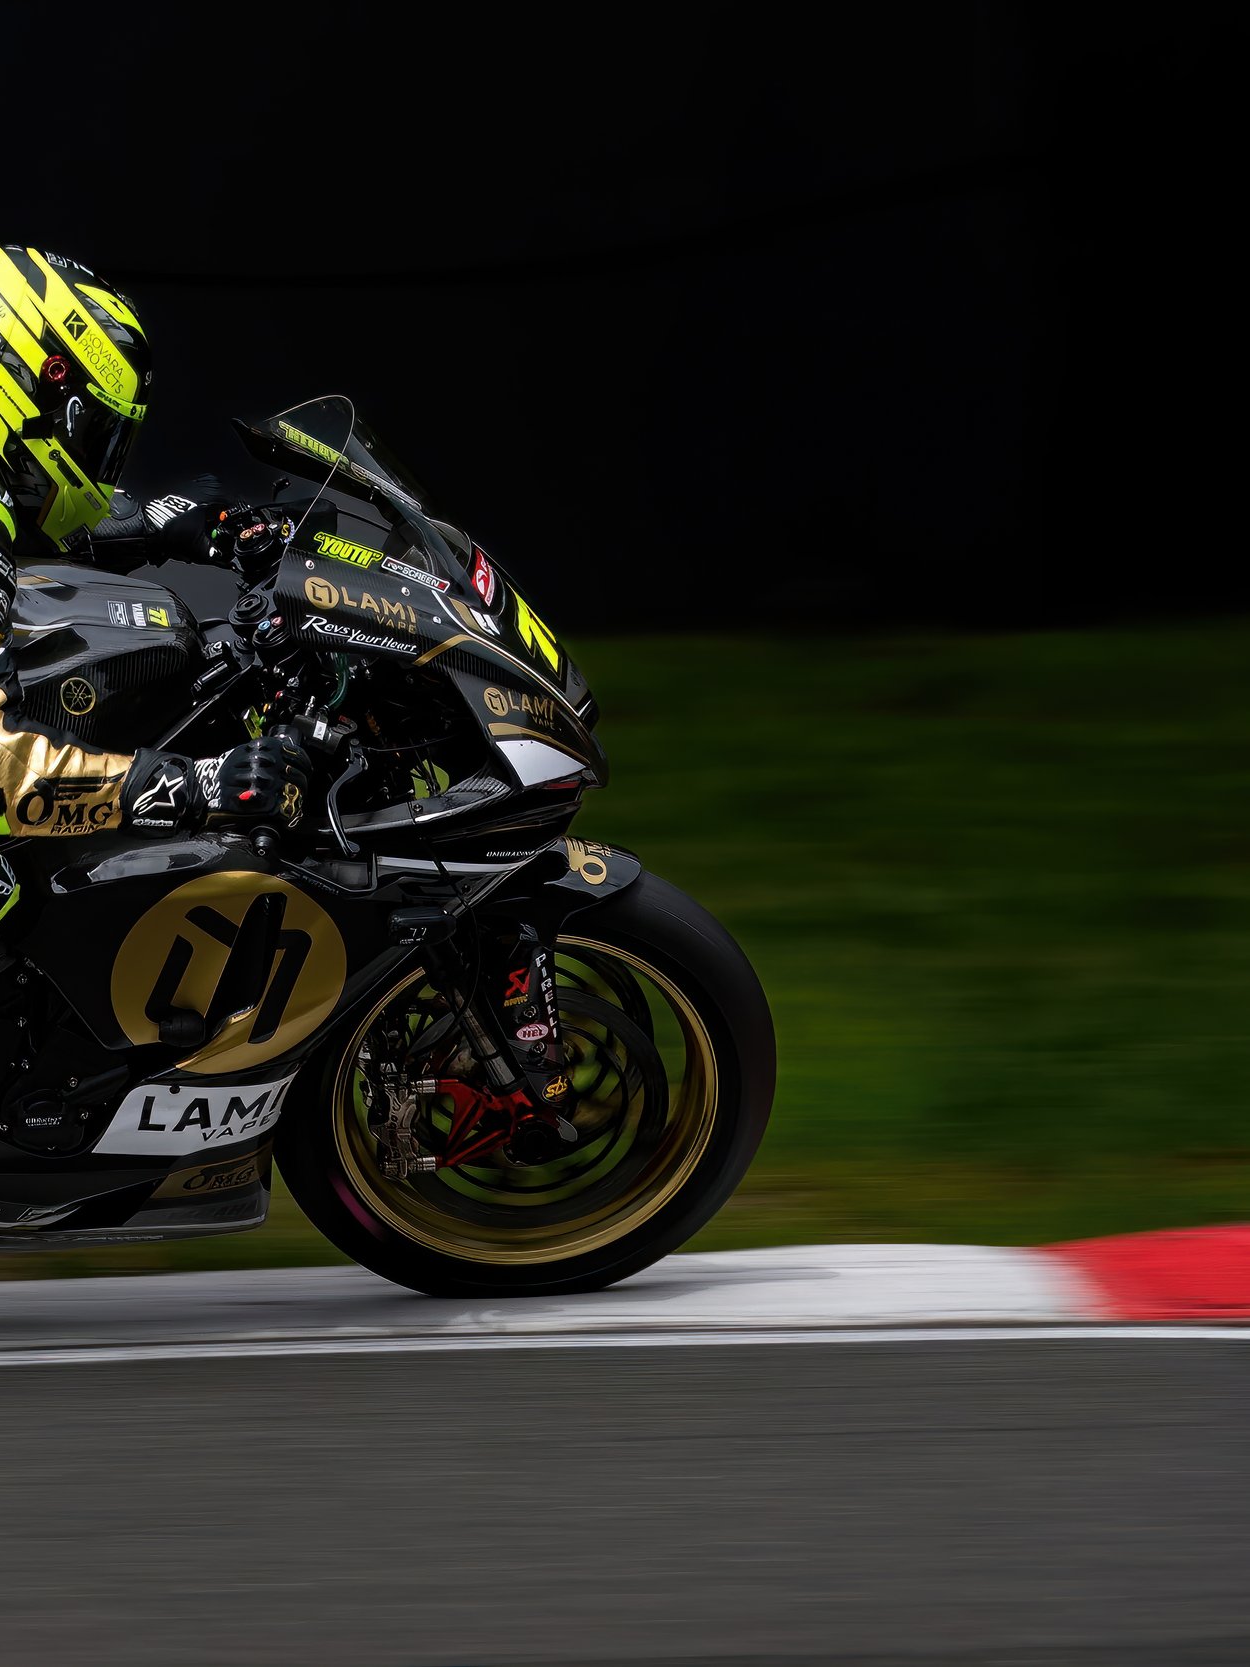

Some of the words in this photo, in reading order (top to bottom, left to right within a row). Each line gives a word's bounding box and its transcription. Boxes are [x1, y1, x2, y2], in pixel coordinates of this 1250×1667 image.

[78, 338, 125, 396] PROJECTS
[85, 329, 124, 377] KOVARA
[341, 587, 417, 624] LAMI
[375, 614, 417, 633] VAPE
[507, 689, 556, 720] LAMI
[16, 788, 114, 827] OMG
[535, 952, 558, 1040] PIRELLI
[137, 1081, 289, 1132] LAMI
[202, 1111, 272, 1143] VAPE
